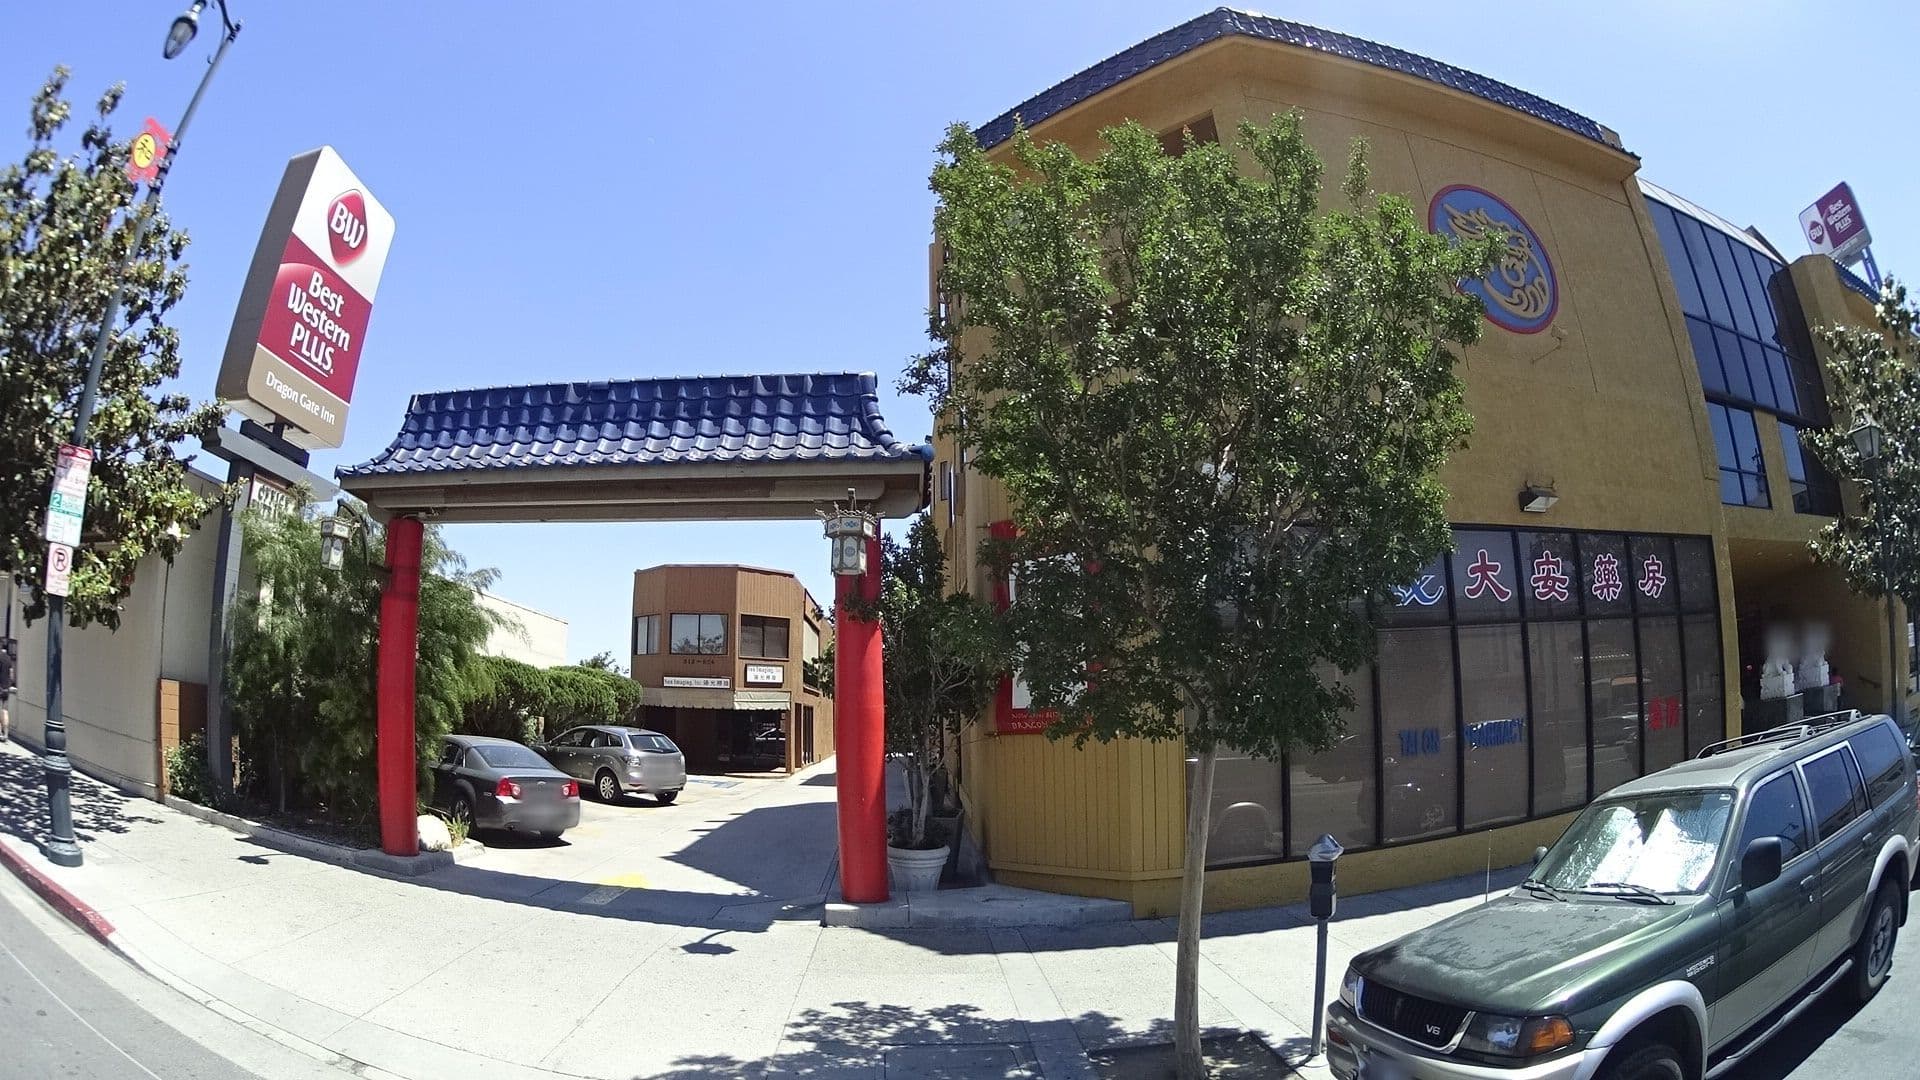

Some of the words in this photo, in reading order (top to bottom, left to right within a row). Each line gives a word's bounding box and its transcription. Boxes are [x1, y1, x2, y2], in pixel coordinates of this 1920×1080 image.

[330, 201, 365, 249] BW
[1828, 200, 1844, 214] Best
[1835, 215, 1852, 232] PLUS
[1810, 225, 1823, 240] BW
[287, 283, 350, 351] Western
[308, 271, 344, 317] Best
[290, 322, 335, 373] PLUS
[266, 371, 299, 403] Dragon
[299, 393, 320, 418] Gate
[320, 405, 336, 425] Inn
[1464, 549, 1666, 602] 大安藥房
[1426, 1024, 1440, 1035] V6
